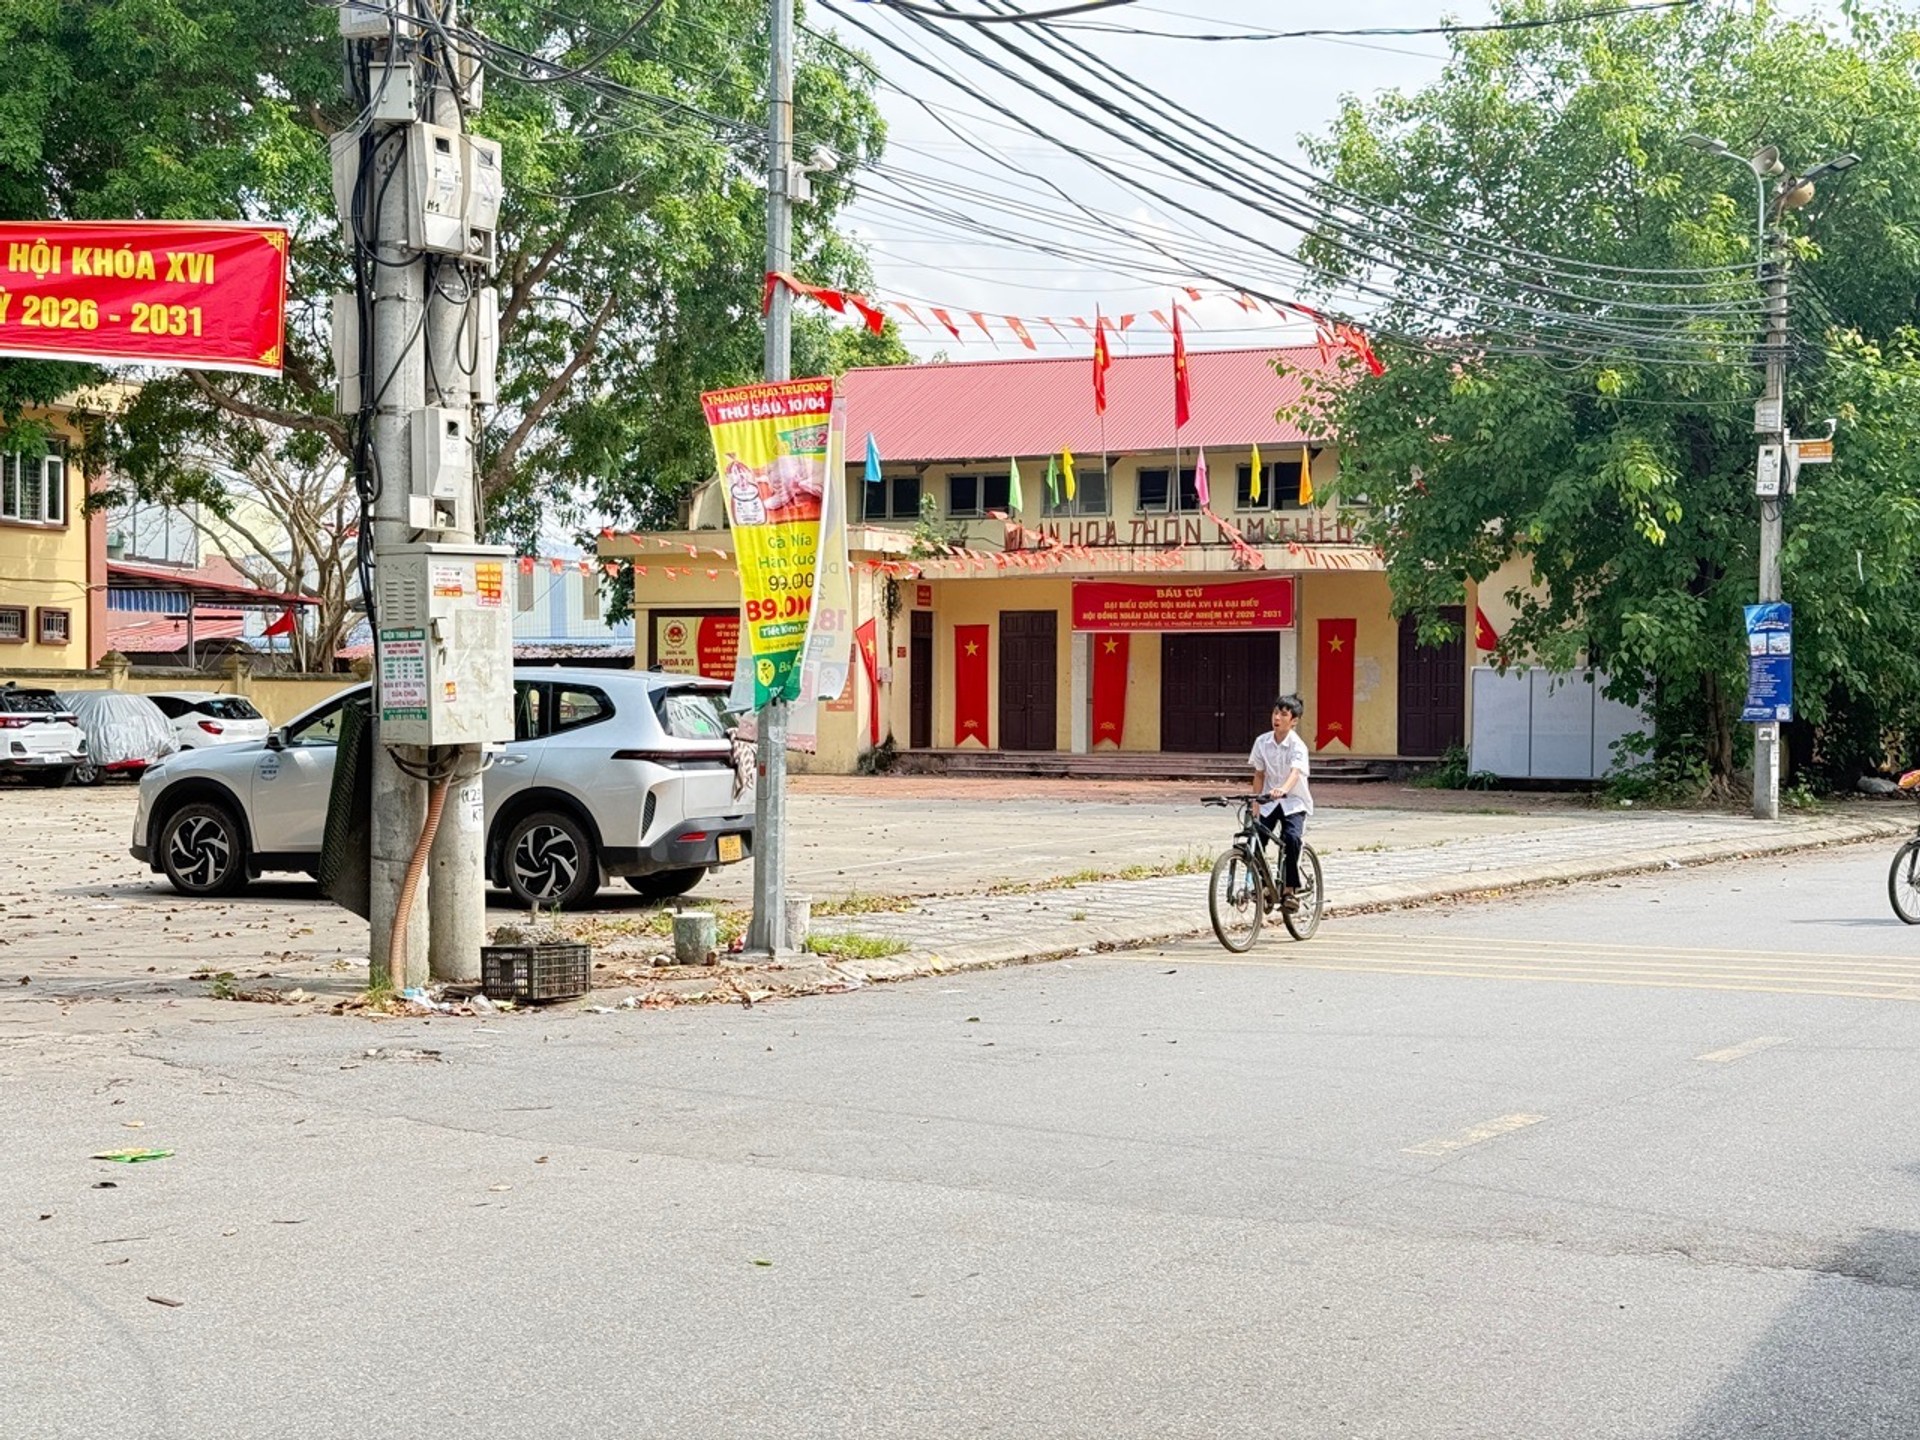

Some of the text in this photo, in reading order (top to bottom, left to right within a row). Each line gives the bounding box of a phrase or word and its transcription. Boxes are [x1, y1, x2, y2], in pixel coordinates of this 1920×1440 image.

[9, 237, 215, 284] HỘI KHÓA XVI
[21, 295, 98, 330] 2026
[130, 302, 202, 337] 2031
[718, 397, 826, 420] THỨ SÁU, 10/04
[1156, 586, 1182, 598] BẦU
